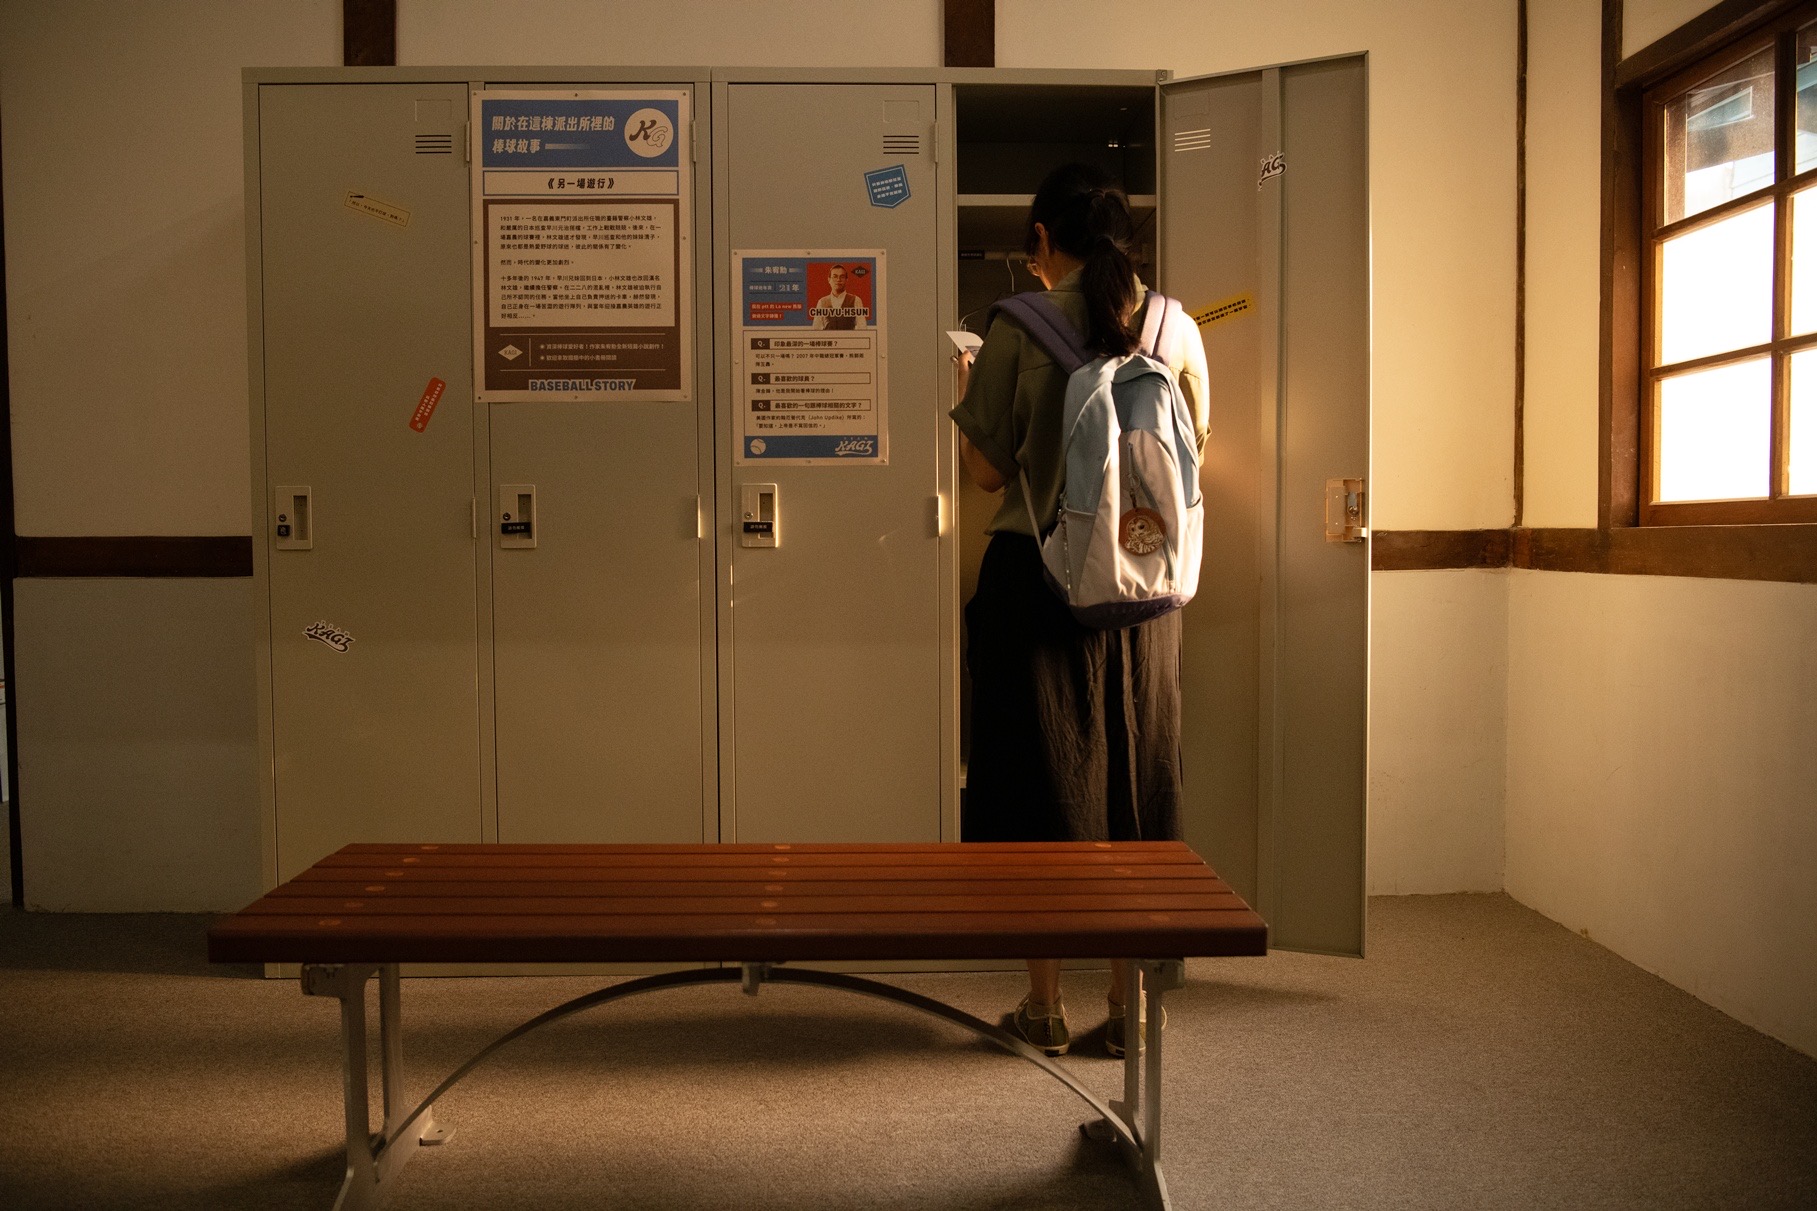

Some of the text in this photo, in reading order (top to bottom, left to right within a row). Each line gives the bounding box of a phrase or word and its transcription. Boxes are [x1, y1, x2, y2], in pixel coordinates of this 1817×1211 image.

[491, 116, 616, 131] 關於在這棟派出所裡的
[491, 138, 541, 154] 棒球故事
[547, 178, 615, 190] 《另一場遊行》
[810, 308, 828, 316] CHU
[530, 380, 634, 391] BASEBALL STORY
